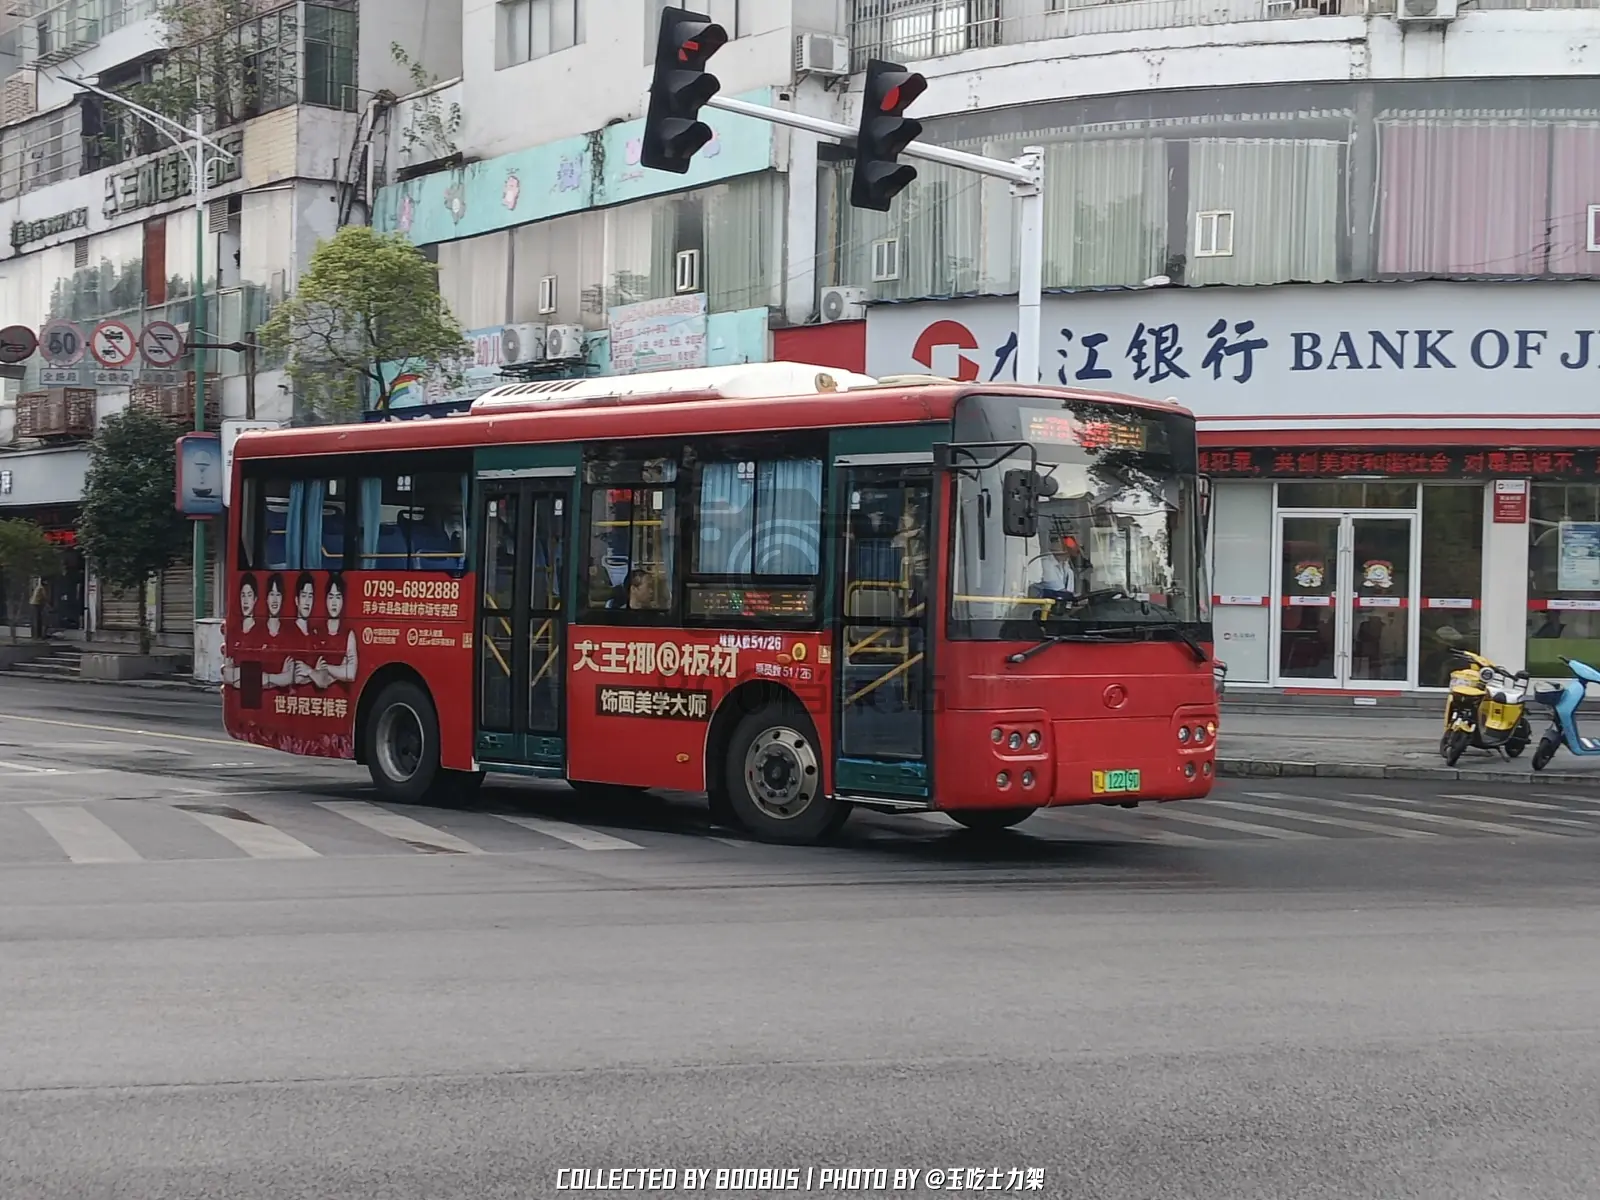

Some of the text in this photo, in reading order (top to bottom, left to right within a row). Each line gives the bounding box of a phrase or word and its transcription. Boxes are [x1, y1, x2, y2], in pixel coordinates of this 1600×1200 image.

[1290, 329, 1456, 370] BANK
[1470, 328, 1548, 370] OF
[363, 579, 460, 600] 0799-6892888
[273, 695, 349, 719] 世界冠军推荐
[600, 688, 708, 719] 饰面美学大师
